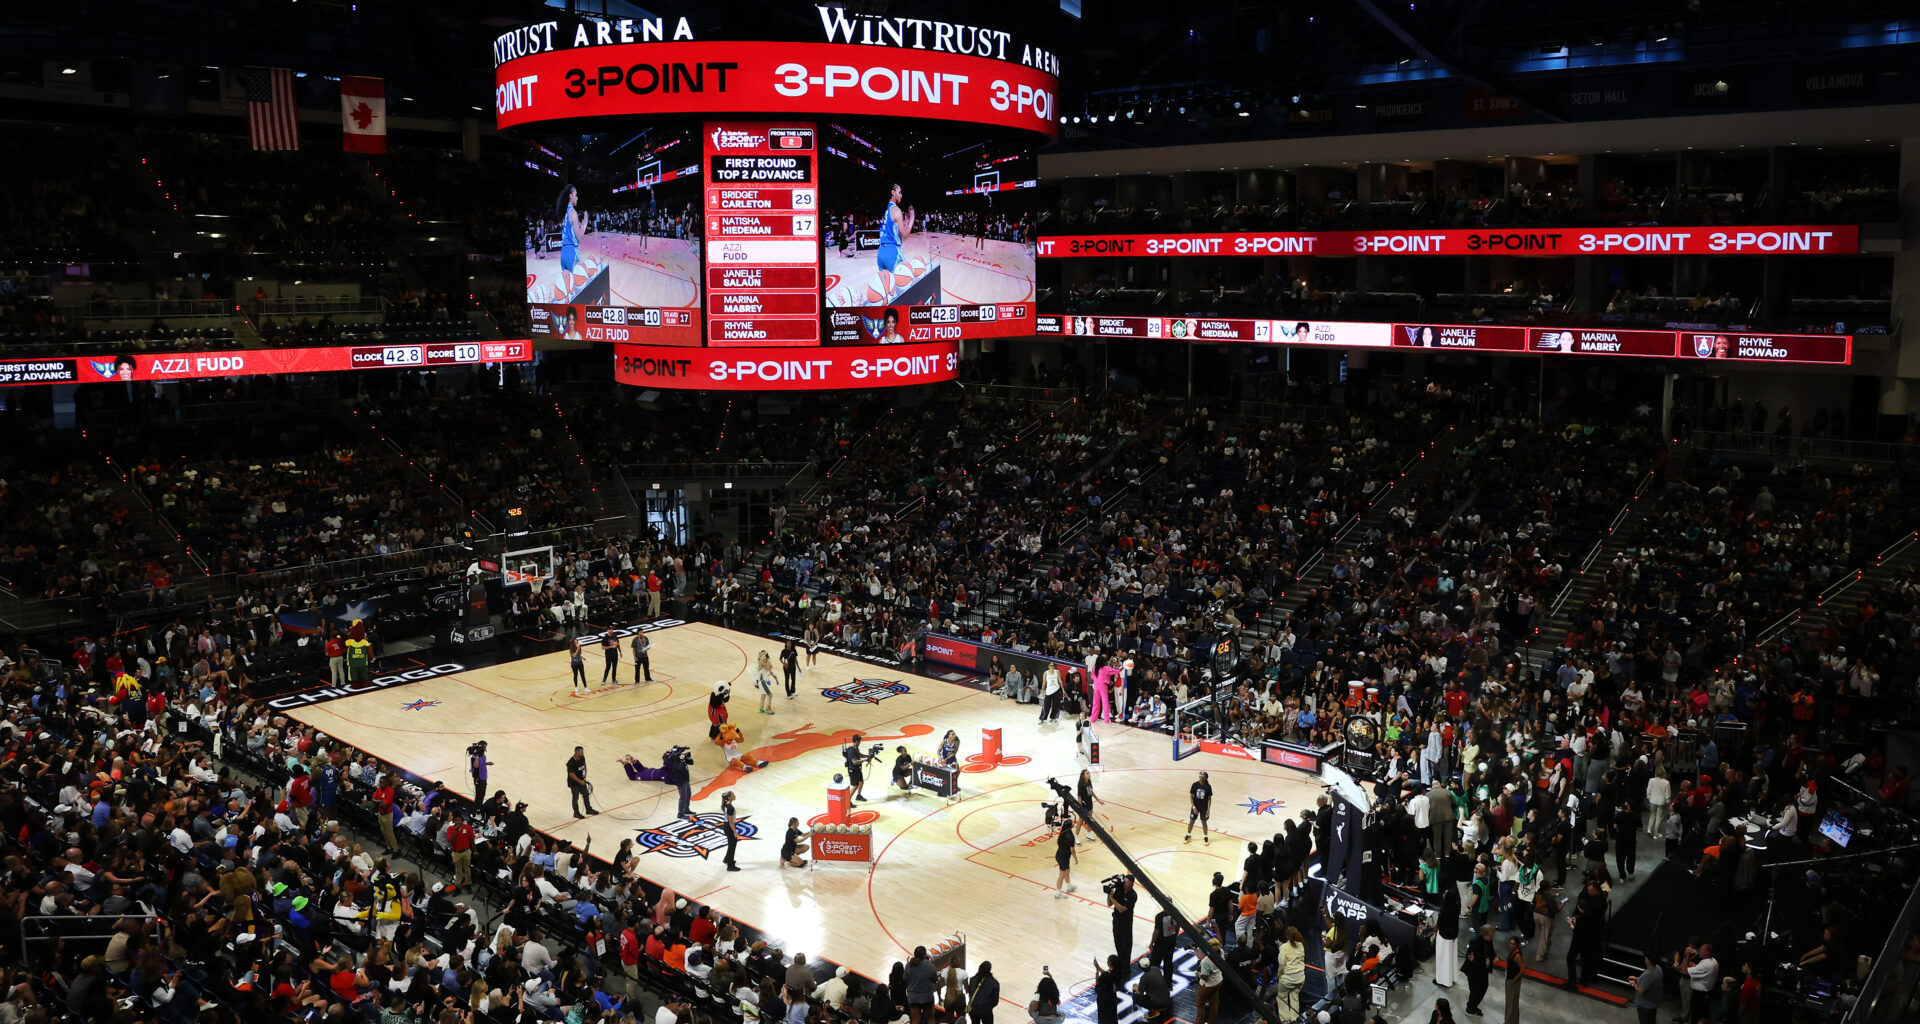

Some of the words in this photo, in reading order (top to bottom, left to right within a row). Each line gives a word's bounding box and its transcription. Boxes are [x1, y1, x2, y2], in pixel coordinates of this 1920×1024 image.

[573, 16, 694, 48] ARENA
[815, 4, 1010, 60] WINTRUST
[564, 62, 738, 99] 3-POINT
[774, 63, 969, 106] 3-POINT
[1571, 91, 1599, 105] SETON
[1604, 89, 1628, 104] HALL
[1375, 102, 1424, 118] PROVIDENCE
[725, 158, 755, 168] FIRST
[757, 158, 797, 168] ROUND
[717, 170, 740, 180] TOP
[741, 170, 749, 180] 2
[750, 170, 805, 180] ADVANCE
[711, 195, 717, 204] 1
[721, 190, 759, 199] BRIDGET
[795, 194, 812, 205] 29
[721, 200, 772, 208] CARLETON
[711, 222, 718, 230] 2
[721, 217, 760, 225] NATISHA
[796, 220, 812, 231] 17
[722, 226, 772, 235] HIEDEMAN
[723, 243, 742, 252] AZZI
[1069, 239, 1135, 253] 3-POINT
[1146, 238, 1223, 254] 3-POINT
[1234, 237, 1318, 253] 3-POINT
[1353, 235, 1446, 252] 3-POINT
[1466, 233, 1562, 250] 3-POINT
[1578, 233, 1691, 251] 3-POINT
[1708, 231, 1833, 251] 3-POINT
[723, 252, 748, 261] FUDD
[723, 269, 762, 278] JANELLE
[723, 296, 760, 304] MARINA
[724, 304, 763, 313] MABREY
[960, 309, 979, 318] SCORE
[981, 306, 994, 319] 10
[1015, 307, 1025, 316] 17
[586, 311, 603, 319] CLOCK
[604, 309, 624, 323] 42.8
[627, 313, 645, 321] SCORE
[647, 311, 658, 324] 10
[680, 313, 689, 323] 17
[910, 311, 931, 320] CLOCK
[932, 308, 956, 323] 42.8
[724, 321, 754, 330] RHYNE
[1066, 321, 1072, 330] 1
[1099, 319, 1125, 327] BRIDGET
[1149, 323, 1160, 333] 29
[1201, 321, 1230, 330] NATISHA
[909, 327, 931, 340] AZZI
[934, 326, 962, 339] FUDD
[1099, 326, 1133, 335] CARLETON
[1164, 325, 1171, 333] 2
[1201, 329, 1239, 338] HIEDEMAN
[1256, 326, 1268, 336] 17
[1314, 324, 1331, 333] AZZI
[1440, 328, 1476, 338] JANELLE
[585, 327, 603, 340] AZZI
[606, 328, 630, 341] FUDD
[724, 331, 767, 339] HOWARD
[1314, 332, 1335, 341] FUDD
[1581, 332, 1618, 342] MARINA
[1581, 342, 1622, 352] MABREY
[1738, 337, 1773, 348] RHYNE
[353, 352, 382, 362] CLOCK
[386, 348, 419, 363] 42.8
[427, 350, 455, 358] SCORE
[458, 347, 476, 359] 10
[508, 346, 521, 356] 17
[1738, 347, 1788, 358] HOWARD
[0, 363, 26, 373] FIRST
[29, 362, 64, 372] ROUND
[151, 359, 190, 374] AZZI
[196, 356, 244, 372] FUDD
[622, 356, 692, 377] 3-POINT
[709, 360, 833, 381] 3-POINT
[850, 354, 940, 379] 3-POINT
[14, 373, 21, 381] 2
[23, 371, 72, 381] ADVANCE
[926, 644, 955, 656] 3-POINT
[1337, 898, 1367, 913] WNBA
[1337, 905, 1367, 921] APP
